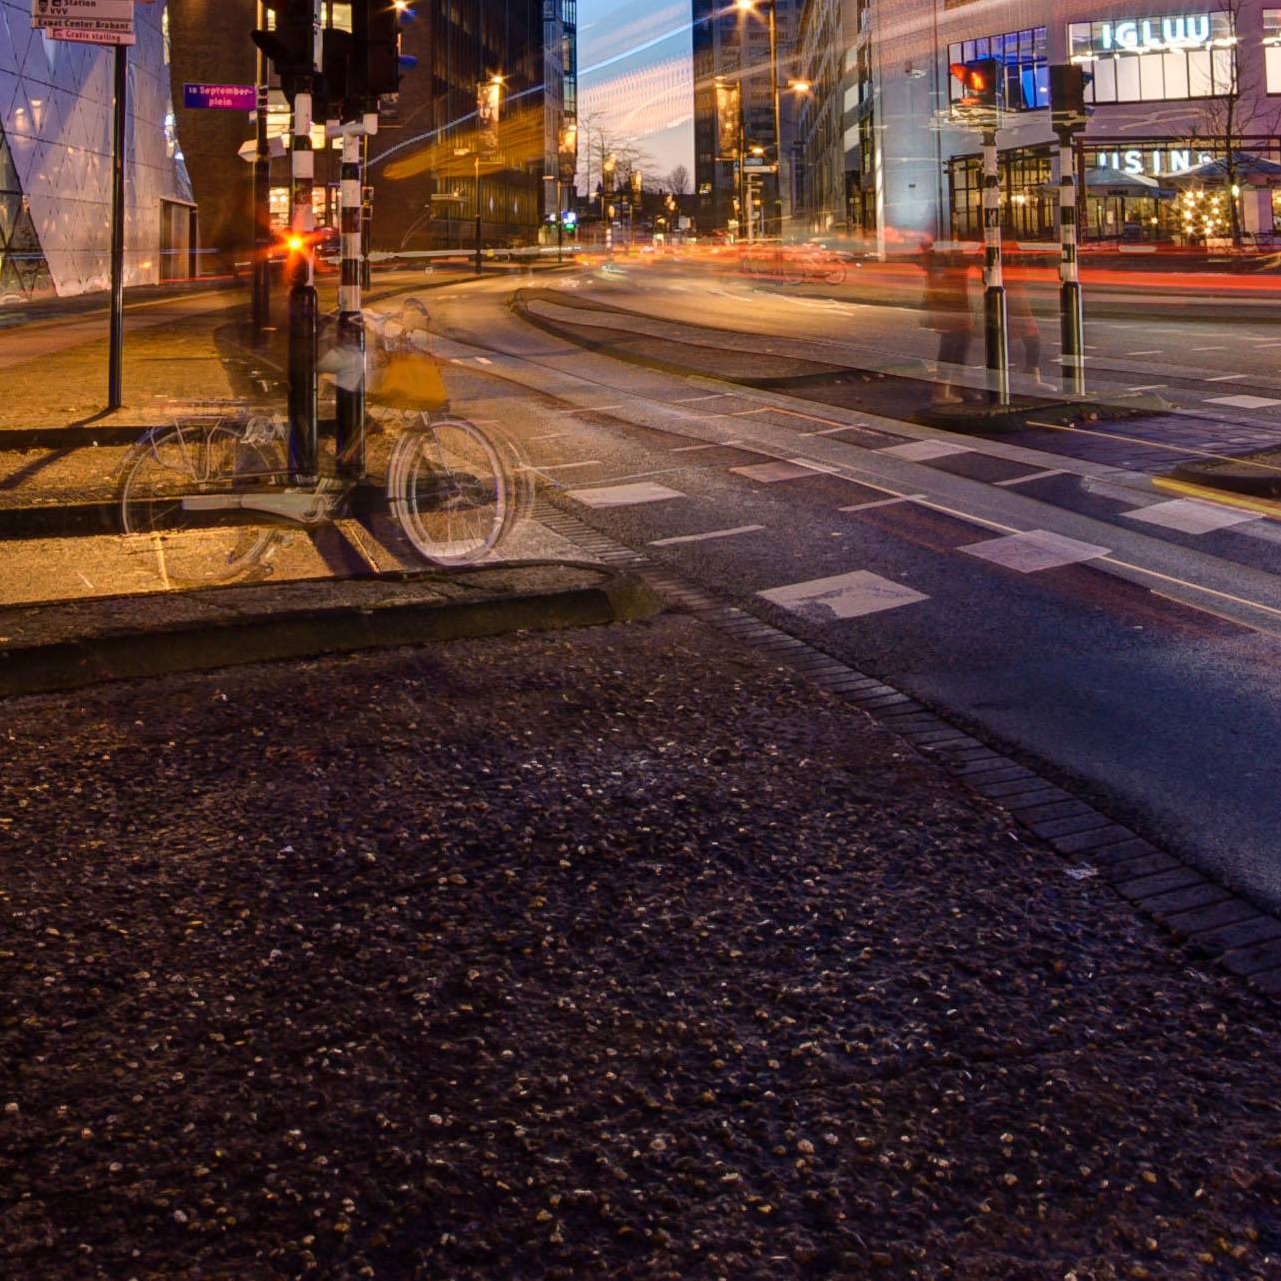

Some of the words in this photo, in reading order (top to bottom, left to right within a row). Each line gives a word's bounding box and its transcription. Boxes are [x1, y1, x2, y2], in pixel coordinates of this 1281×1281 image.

[64, 0, 96, 7] Station
[50, 7, 68, 15] VVV
[95, 21, 129, 30] Brabant
[65, 30, 89, 39] Gratis
[1102, 16, 1209, 50] IGLUU
[208, 97, 233, 107] plein
